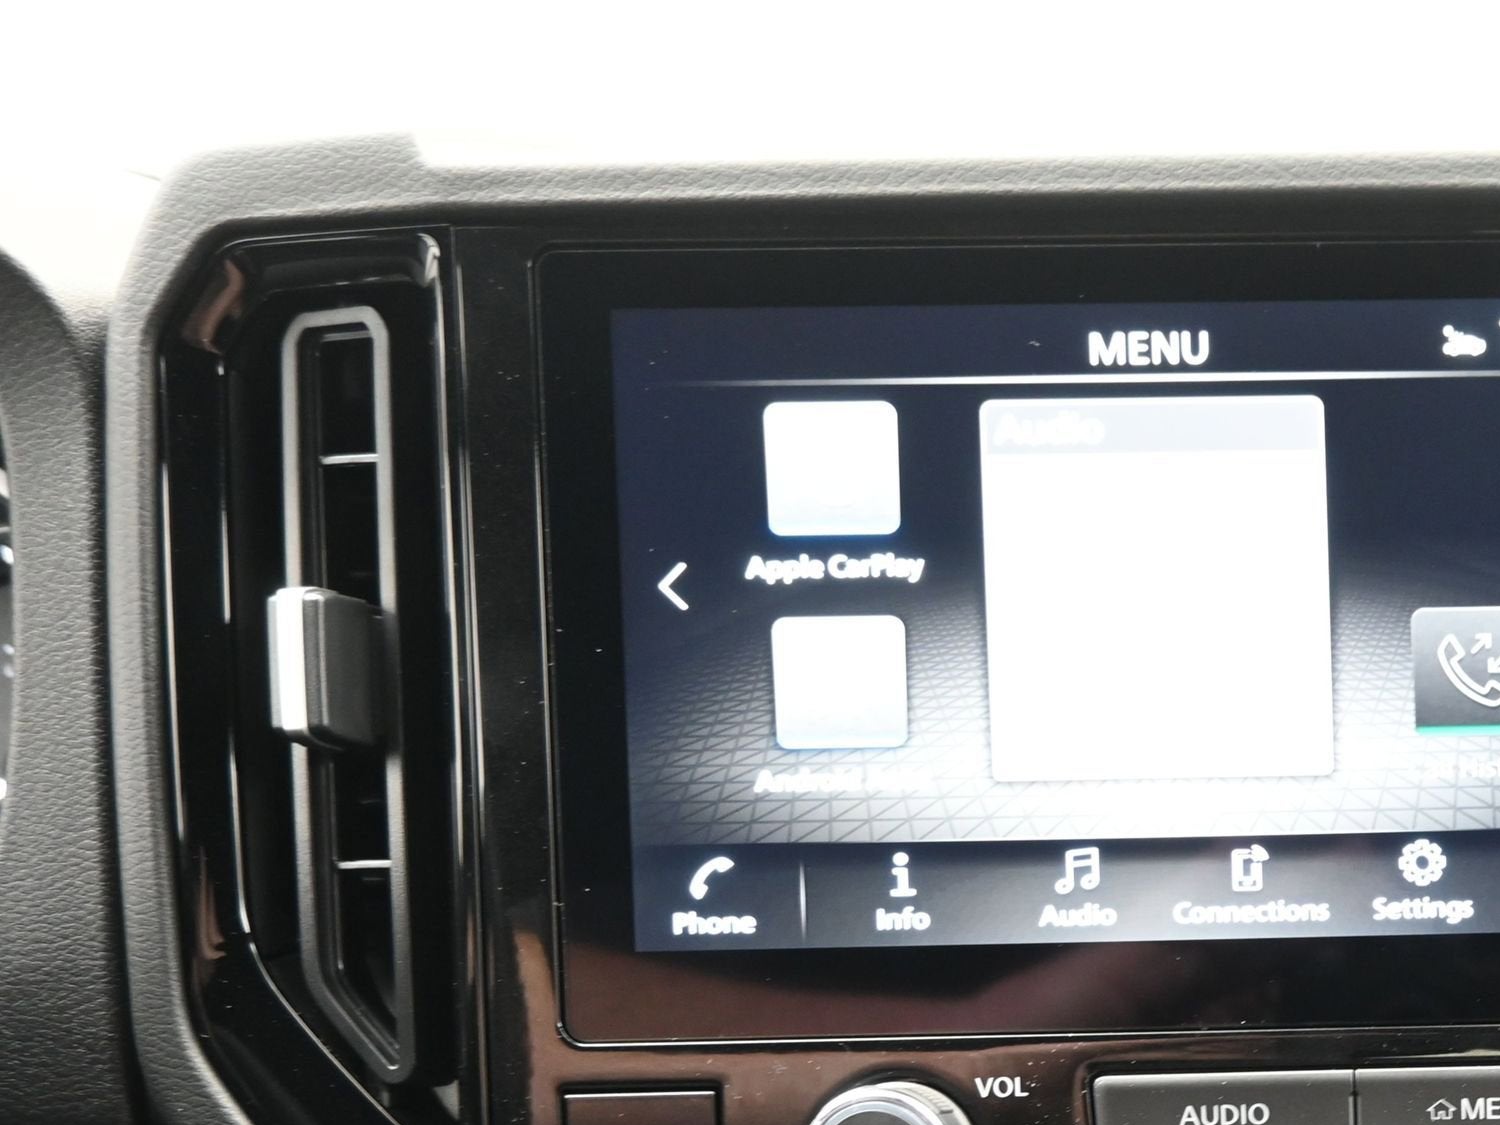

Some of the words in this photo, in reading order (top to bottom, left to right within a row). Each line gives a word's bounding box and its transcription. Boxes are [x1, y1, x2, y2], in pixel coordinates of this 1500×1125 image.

[1087, 330, 1211, 367] MENU
[993, 408, 1104, 448] Audio
[744, 553, 825, 585] Apple
[828, 553, 926, 584] CarPlay
[875, 907, 932, 932] Info
[1038, 902, 1118, 928] Audio
[1173, 899, 1331, 925] Connections
[1372, 895, 1475, 925] Settings
[671, 911, 757, 936] Phone
[974, 1075, 1029, 1099] VOL
